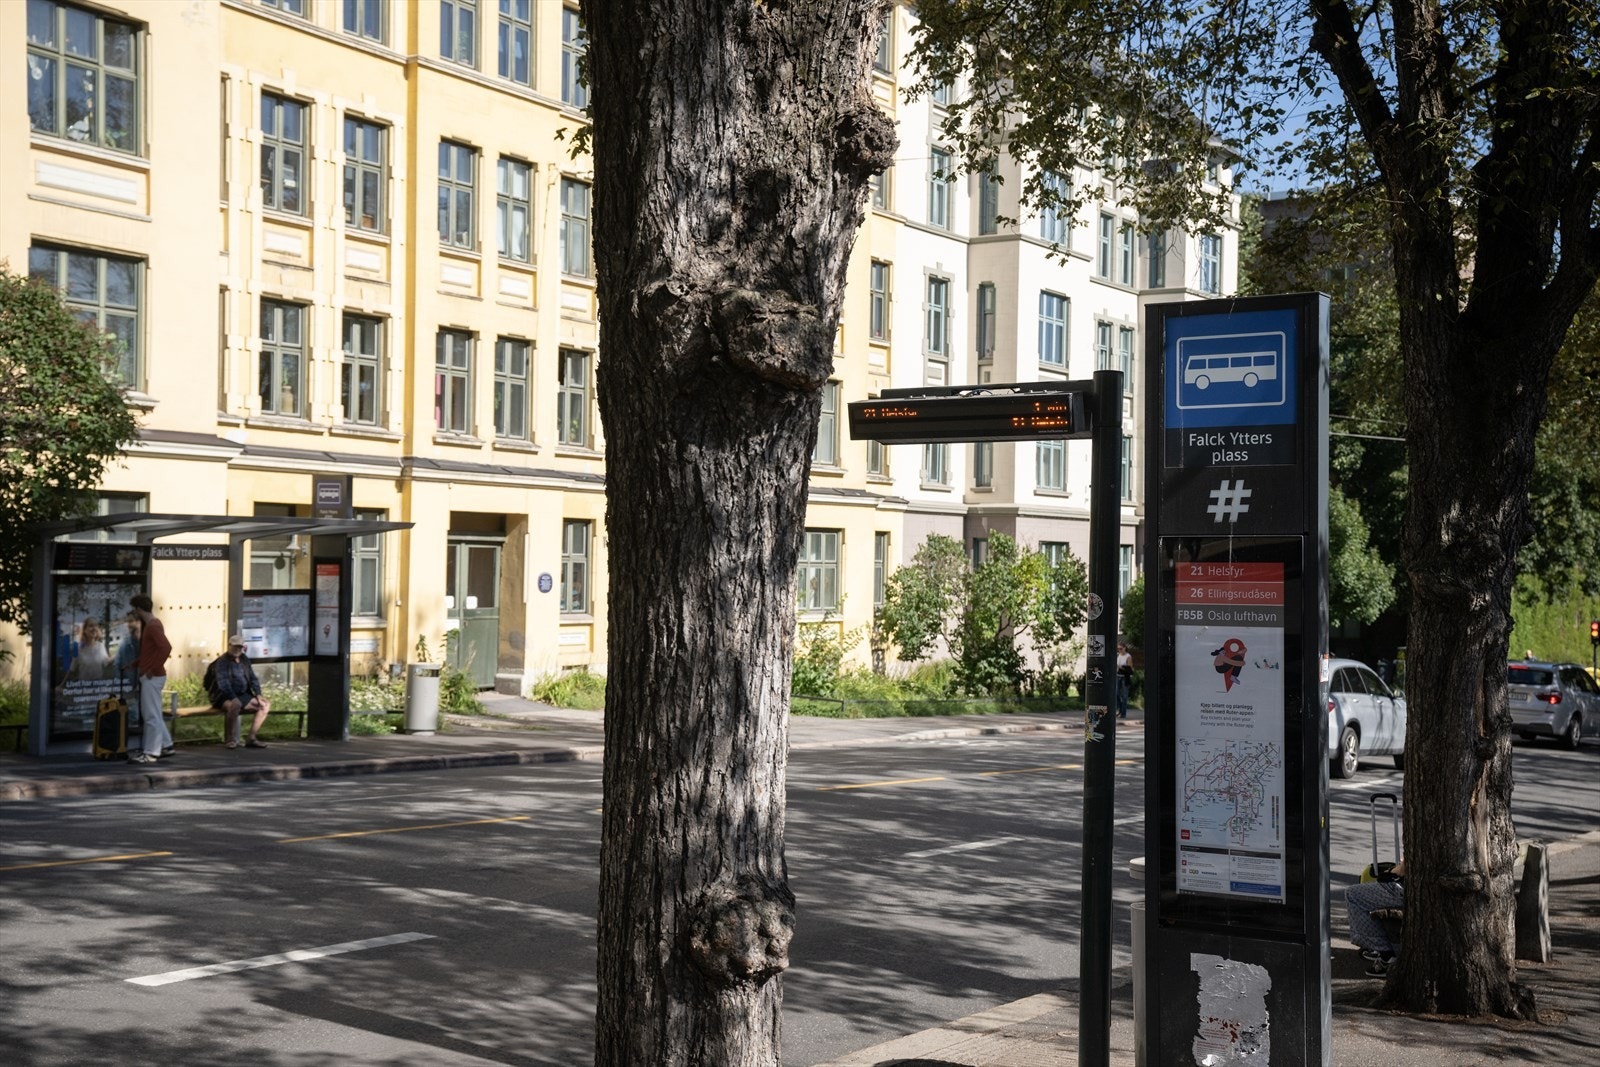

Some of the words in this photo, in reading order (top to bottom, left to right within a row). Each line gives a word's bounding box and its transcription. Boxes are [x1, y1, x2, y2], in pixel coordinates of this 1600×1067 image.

[1189, 433, 1225, 447] Falck
[1229, 432, 1272, 446] Ytters
[1212, 448, 1249, 464] plass
[152, 547, 174, 557] Falck
[175, 547, 201, 557] Ytters
[202, 547, 223, 559] plass
[1190, 565, 1204, 576] 21
[1208, 566, 1245, 578] Helsfyr
[1190, 588, 1204, 598] 26
[1208, 588, 1277, 600] Ellingsrudåsen
[1177, 610, 1204, 620] FB5B
[1208, 610, 1231, 621] Oslo
[1234, 611, 1277, 622] lufthavn
